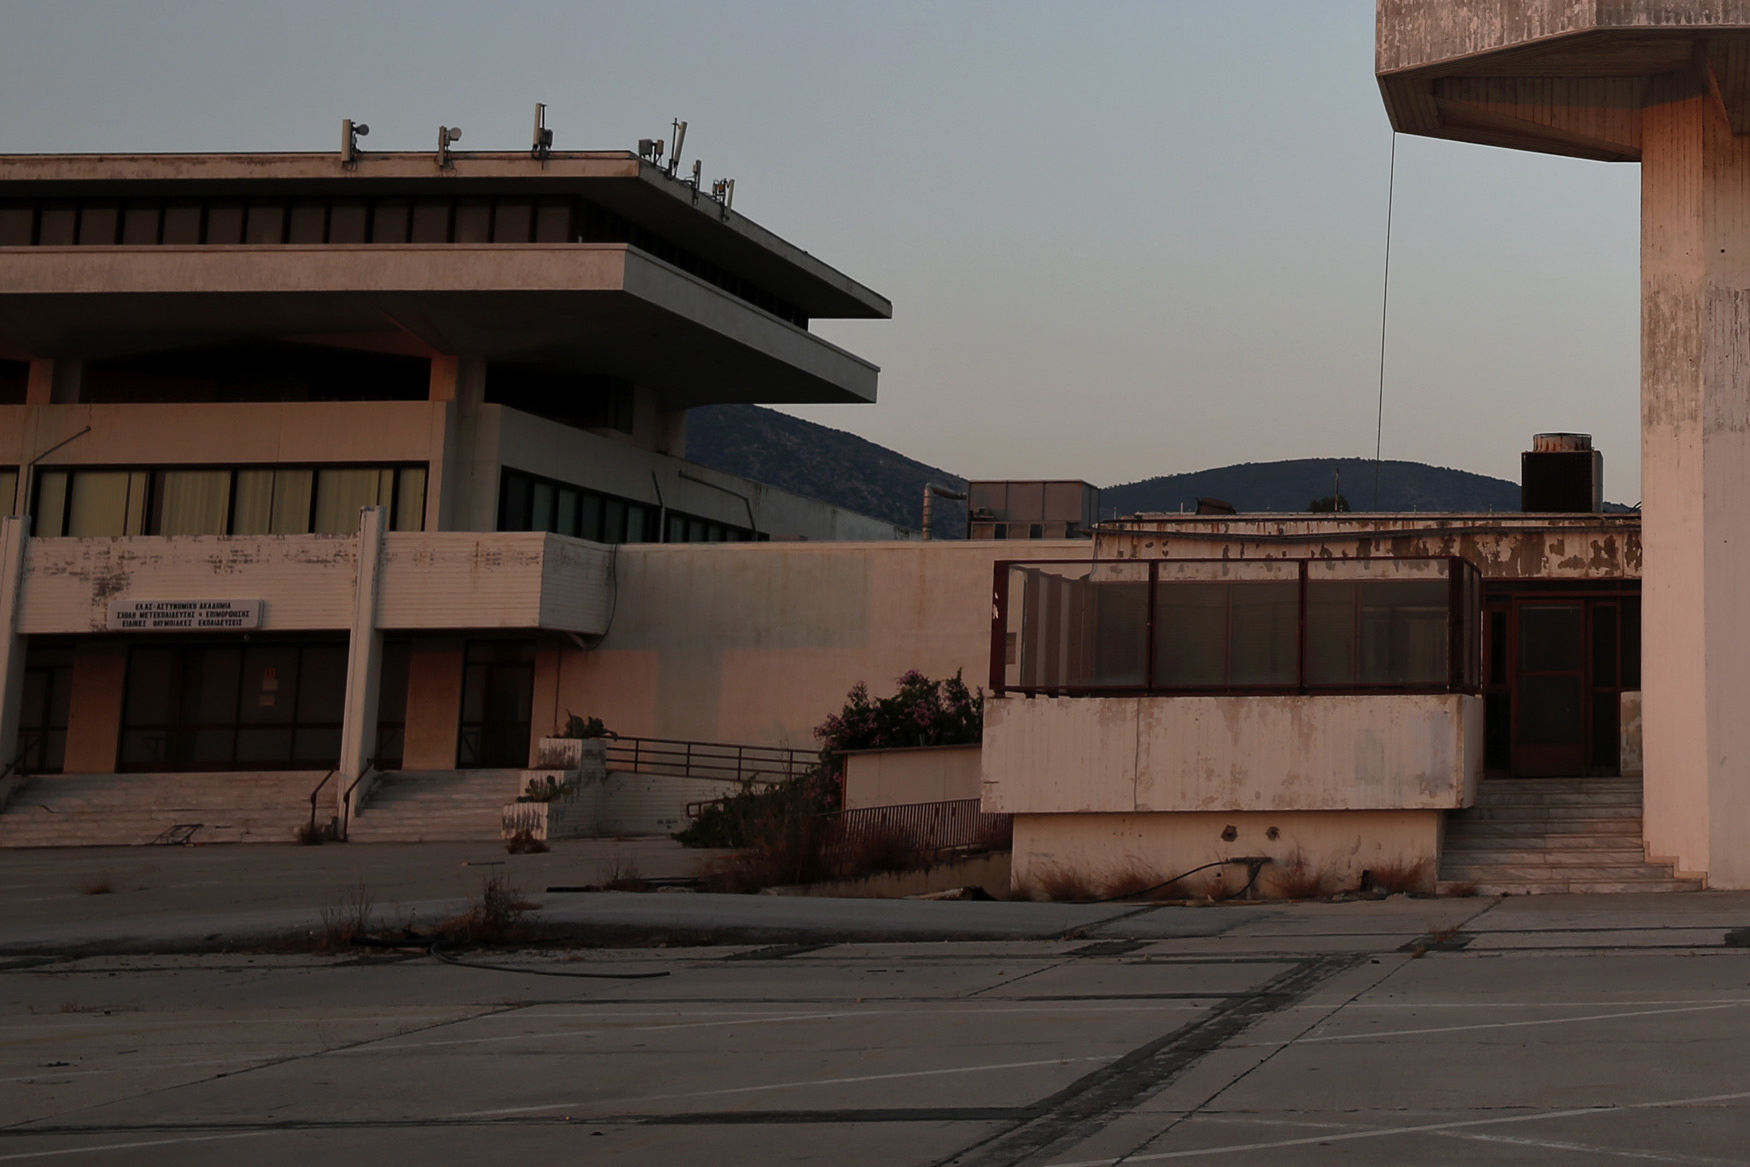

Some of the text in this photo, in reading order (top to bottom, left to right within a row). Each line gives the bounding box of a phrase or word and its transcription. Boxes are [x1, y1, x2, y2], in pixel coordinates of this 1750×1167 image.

[206, 610, 250, 618] ΕΠΙΜΟΡΦΩΣΗΣ
[152, 619, 192, 627] ΟΛΥΜΠΙΑΚΕΣ
[198, 619, 243, 627] ΕΚΠΑΙΔΕΥΣΕΙΣ
